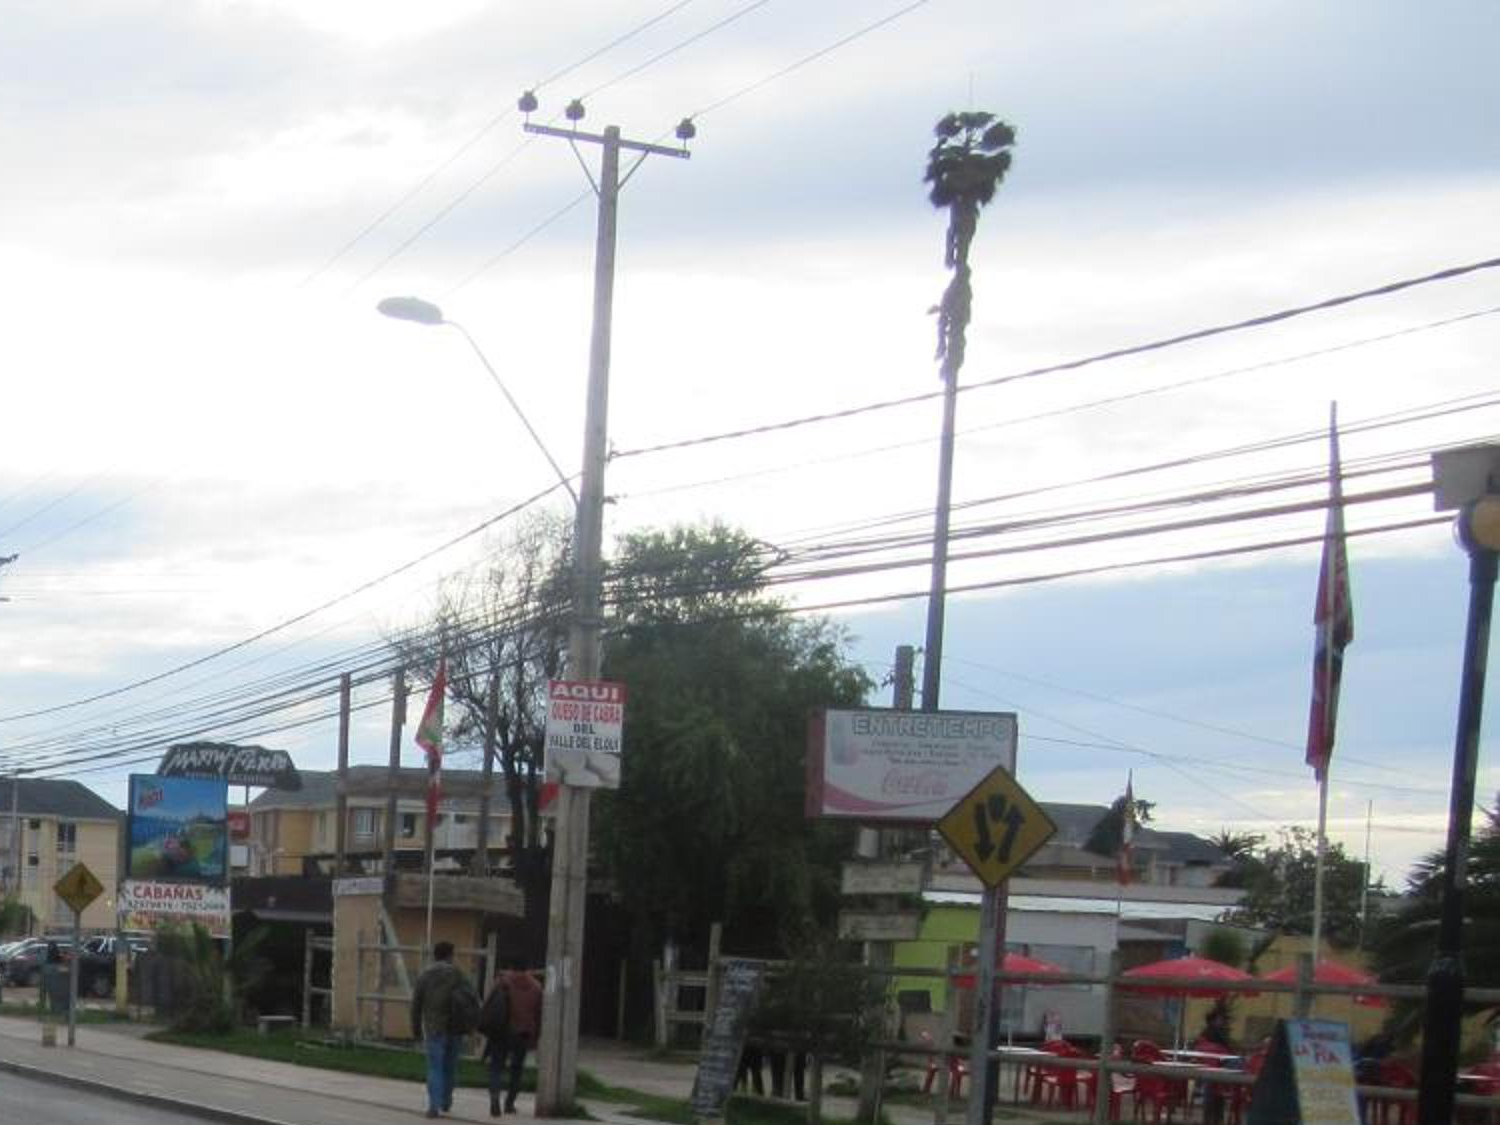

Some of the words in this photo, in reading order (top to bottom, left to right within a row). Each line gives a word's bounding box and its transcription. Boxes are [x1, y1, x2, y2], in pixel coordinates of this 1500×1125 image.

[553, 684, 619, 700] AQUI
[573, 723, 596, 735] DEL
[853, 714, 1007, 740] ENTRETIEMPO
